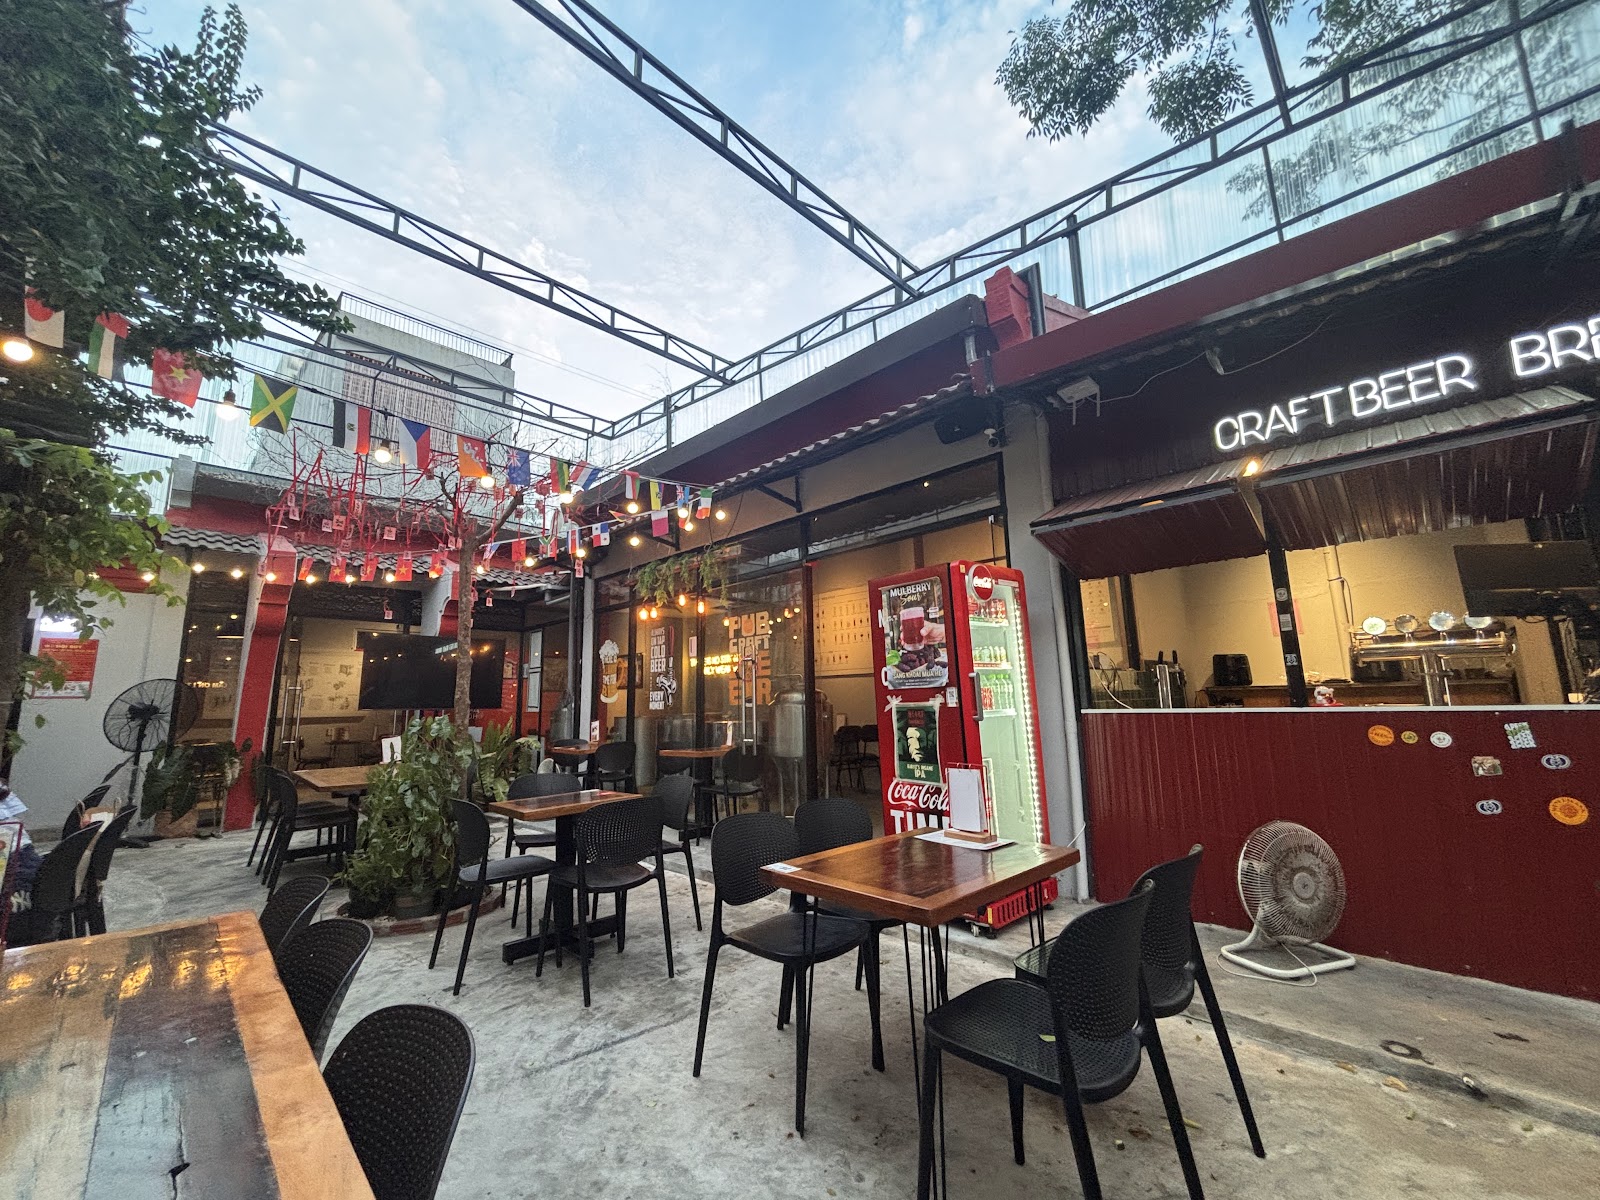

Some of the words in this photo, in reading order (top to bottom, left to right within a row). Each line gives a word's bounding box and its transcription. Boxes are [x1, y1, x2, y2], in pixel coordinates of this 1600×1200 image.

[1213, 386, 1344, 452] CRAFT
[1348, 354, 1479, 418] BEER
[890, 582, 932, 598] MULBERRY
[899, 594, 924, 606] Sour
[728, 611, 771, 640] PUB
[651, 645, 666, 659] COLD
[729, 636, 771, 654] CRAFT
[650, 658, 666, 673] BEER
[650, 691, 665, 702] EVERY
[914, 769, 926, 779] IPA
